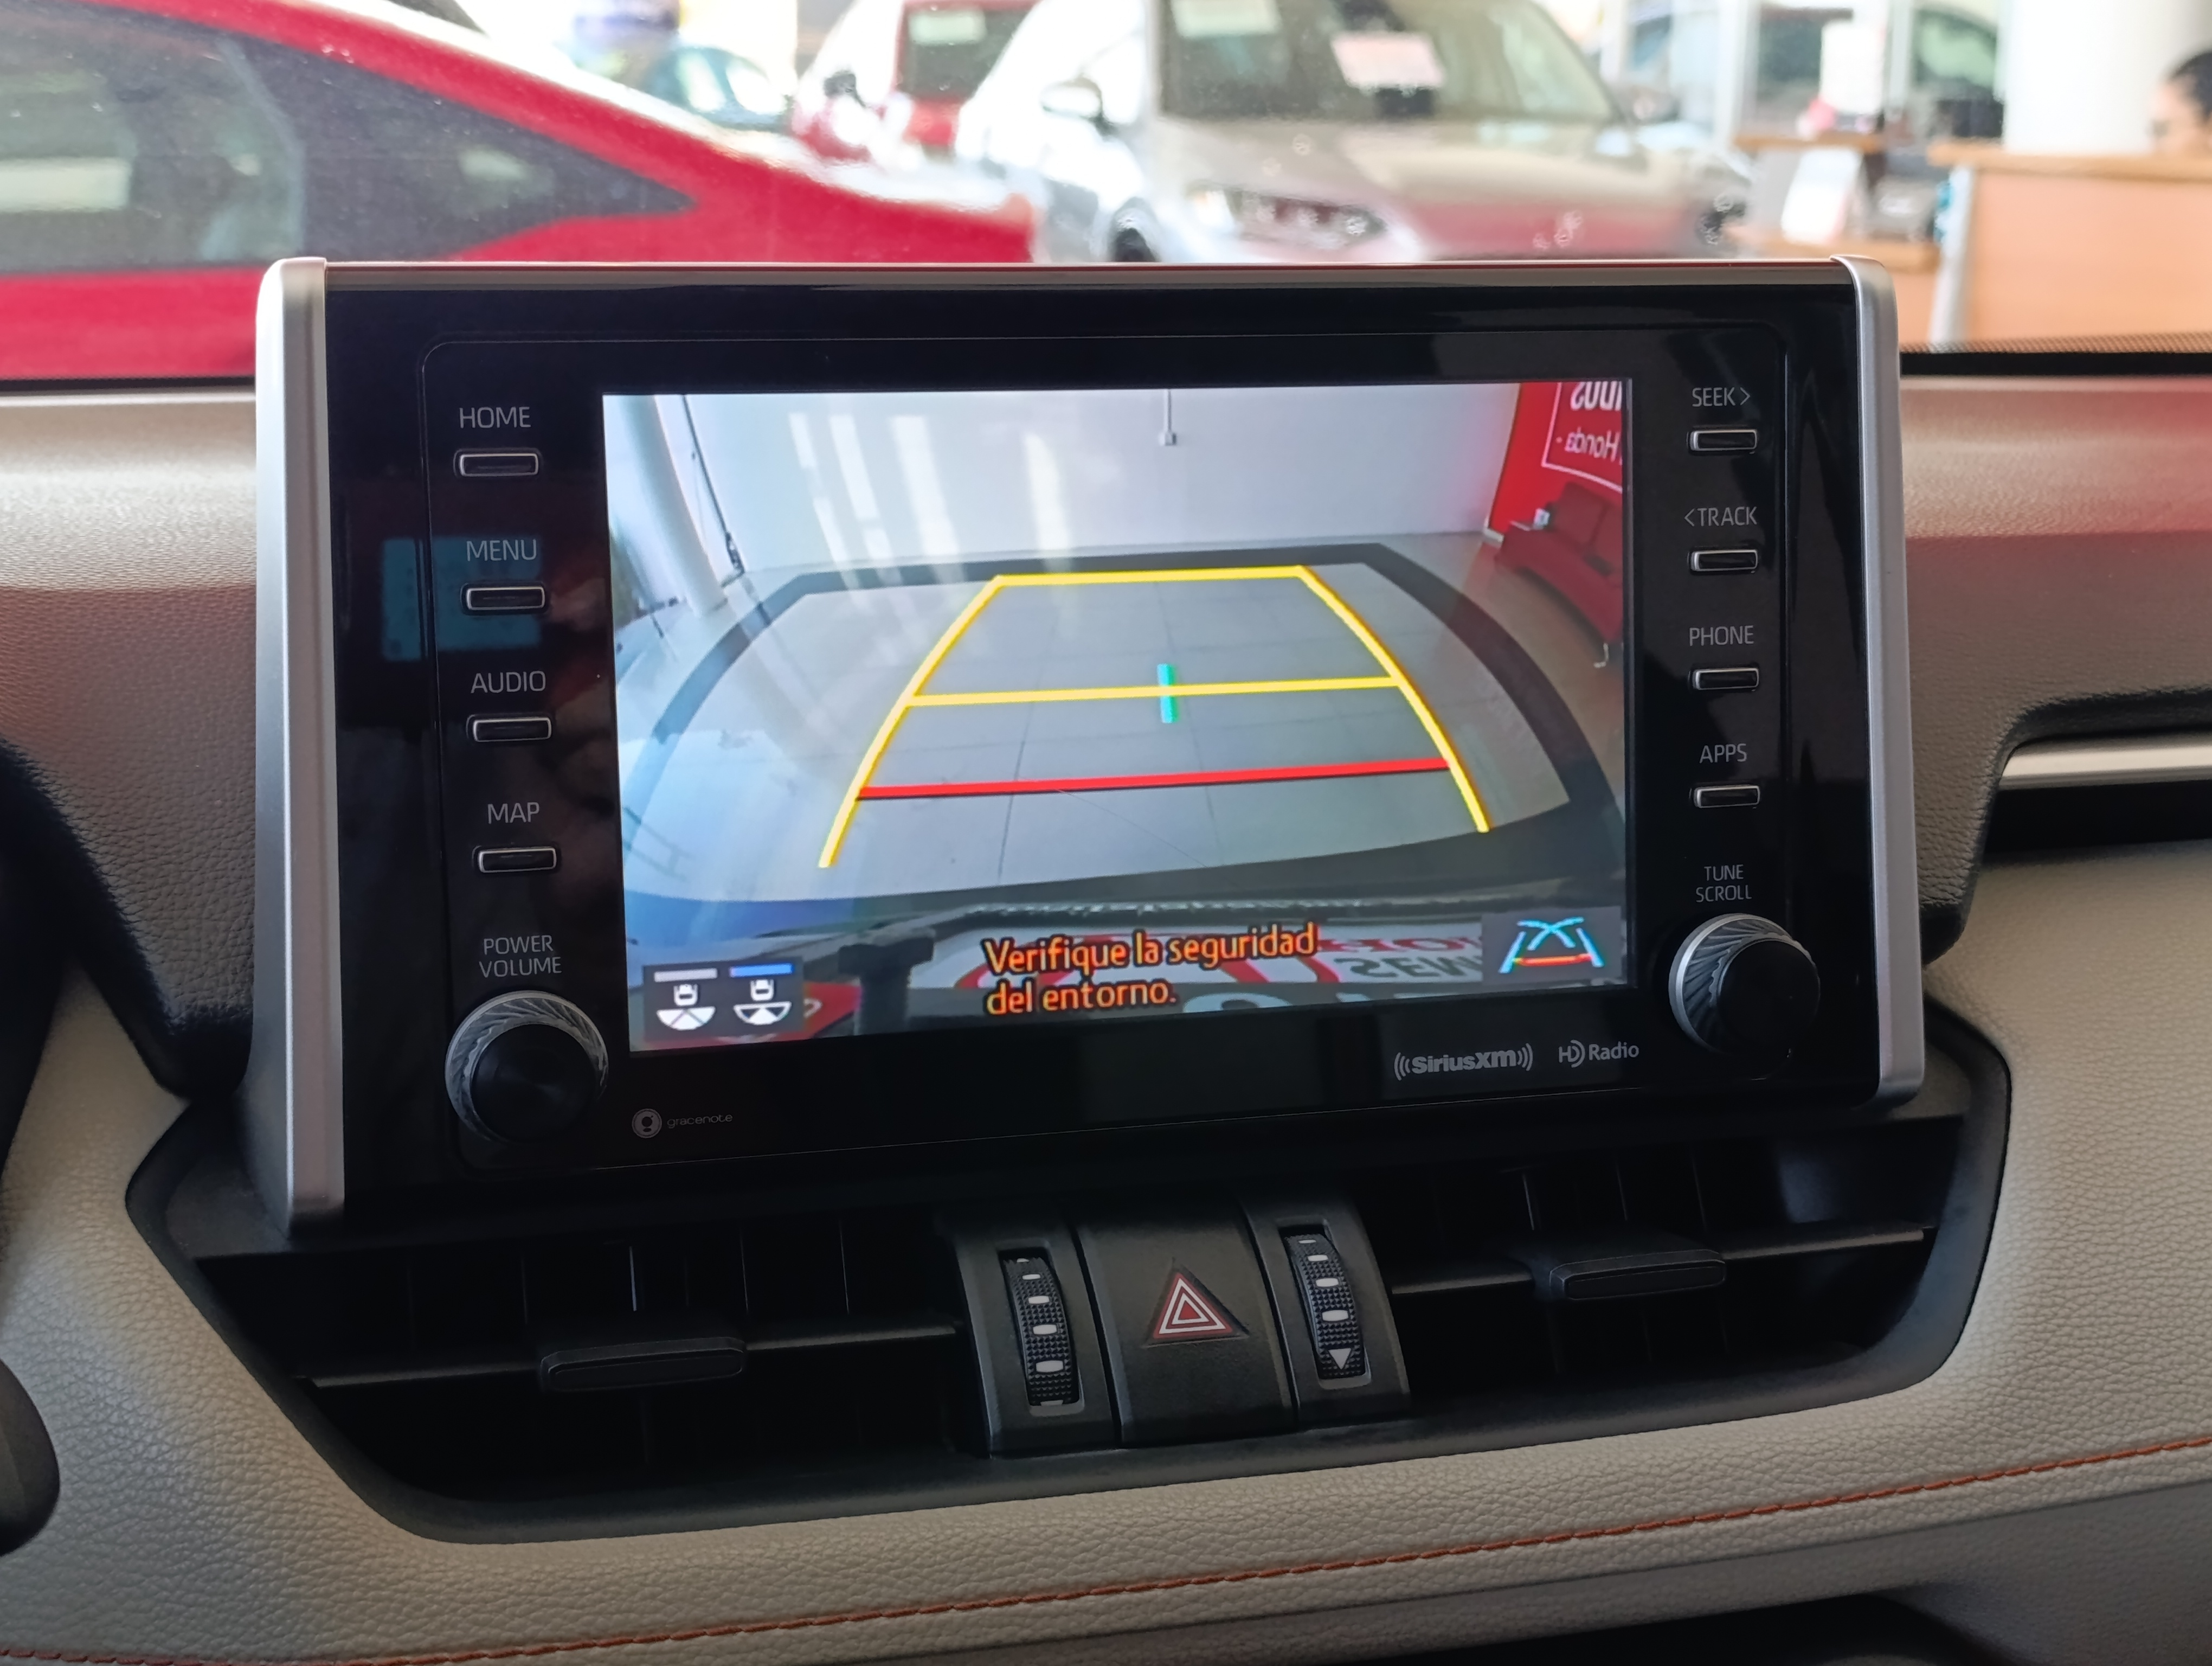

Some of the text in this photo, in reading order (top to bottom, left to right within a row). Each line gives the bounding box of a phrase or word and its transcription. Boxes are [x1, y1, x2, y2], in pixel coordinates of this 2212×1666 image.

[1692, 387, 1735, 407] SEEK
[459, 407, 531, 428] HOME
[1697, 507, 1757, 527] TRACK
[467, 539, 537, 561] MENU
[1689, 625, 1754, 646] PHONE
[471, 671, 546, 694] AUDIO
[1700, 743, 1747, 764] APPS
[487, 802, 540, 824] MAP
[1704, 864, 1744, 881] TUNE
[1696, 884, 1752, 903] SCROLL
[483, 935, 554, 956] POWER
[983, 922, 1315, 977] Verifique la seguridad
[479, 956, 562, 978] VOLUME
[986, 981, 1176, 1016] del entorno.
[1589, 1042, 1639, 1061] Radio
[667, 1114, 733, 1129] gracenote
